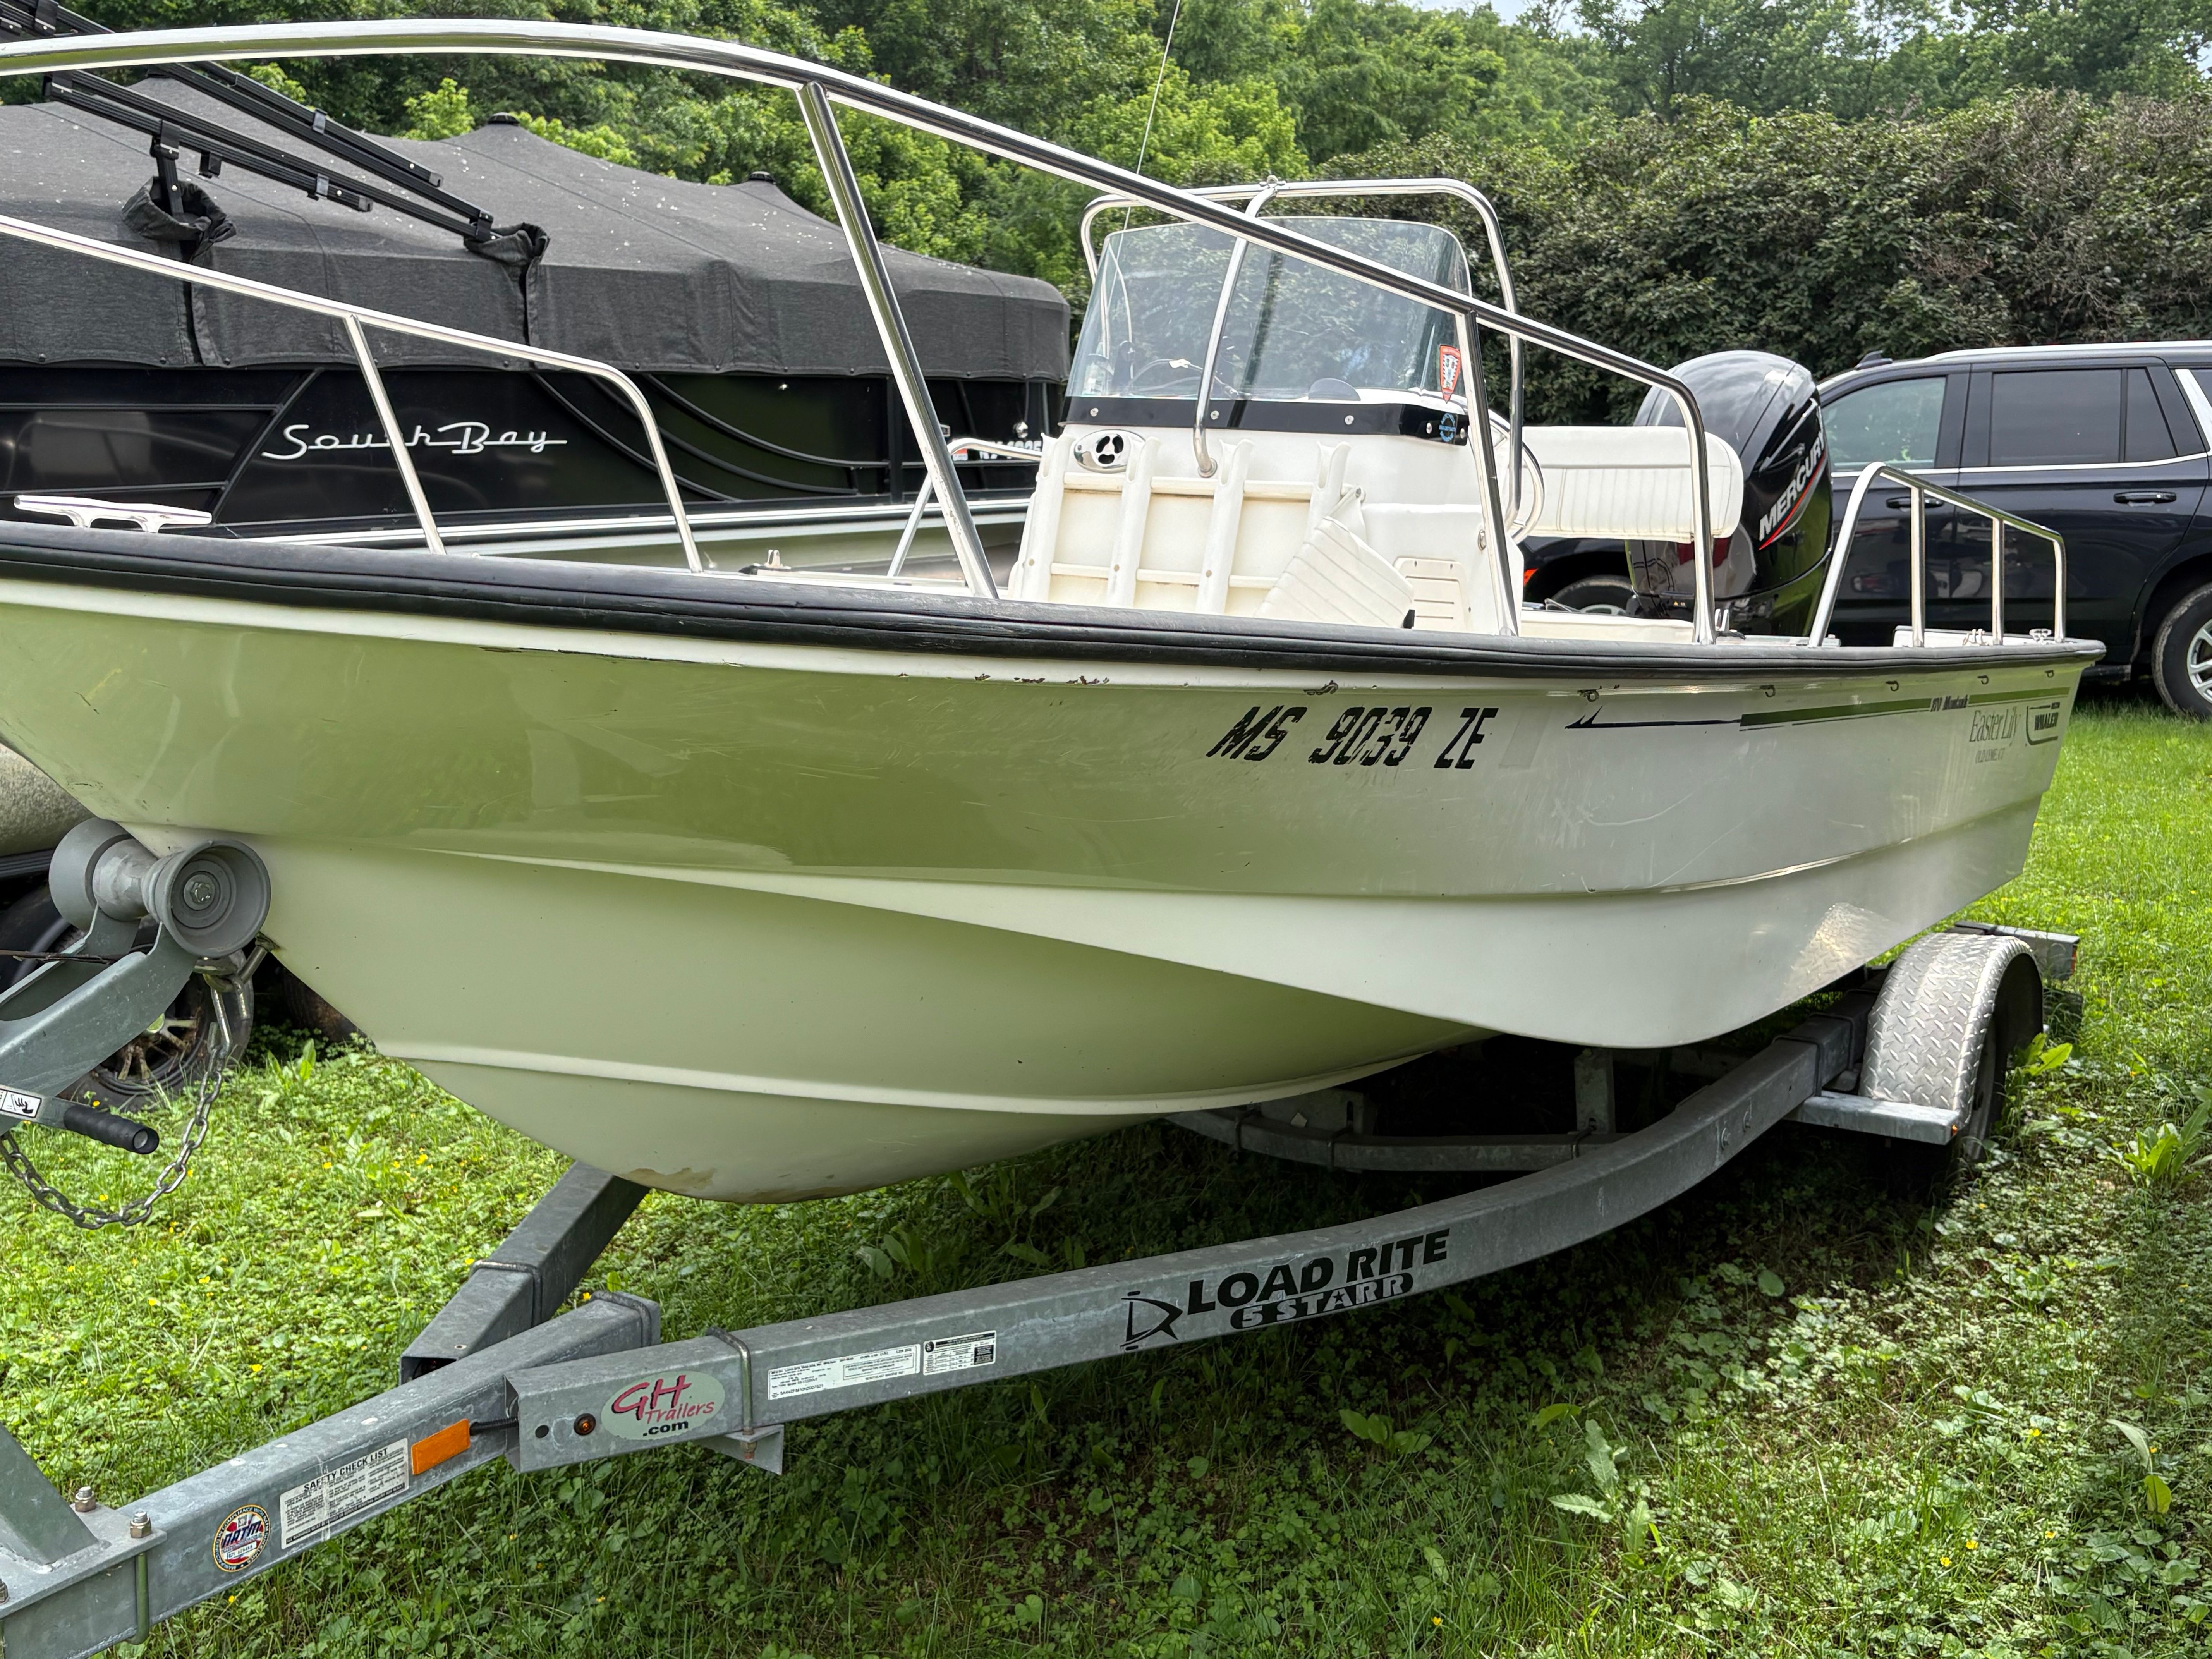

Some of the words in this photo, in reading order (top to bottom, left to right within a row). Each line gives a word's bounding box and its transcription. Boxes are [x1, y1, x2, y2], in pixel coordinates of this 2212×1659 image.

[262, 424, 431, 460] Souh
[438, 422, 567, 453] Bay
[1759, 431, 1824, 542] MERCURY
[1206, 705, 1307, 761] MS
[1308, 706, 1432, 767] 9039
[1433, 707, 1499, 769] ZE
[1969, 710, 2004, 742] Easter
[2001, 706, 2021, 747] Lily
[2034, 712, 2059, 731] WHALER
[1187, 1257, 1334, 1315] LOAD
[1346, 1228, 1450, 1283] RITE
[1242, 1306, 1263, 1328] 5
[1276, 1273, 1404, 1321] STARR
[611, 1375, 692, 1420] GH
[645, 1402, 714, 1424] Trailers
[643, 1421, 689, 1436] .com
[304, 1471, 337, 1491] SAFETY
[340, 1457, 368, 1475] CHECK
[370, 1448, 388, 1461] LIST
